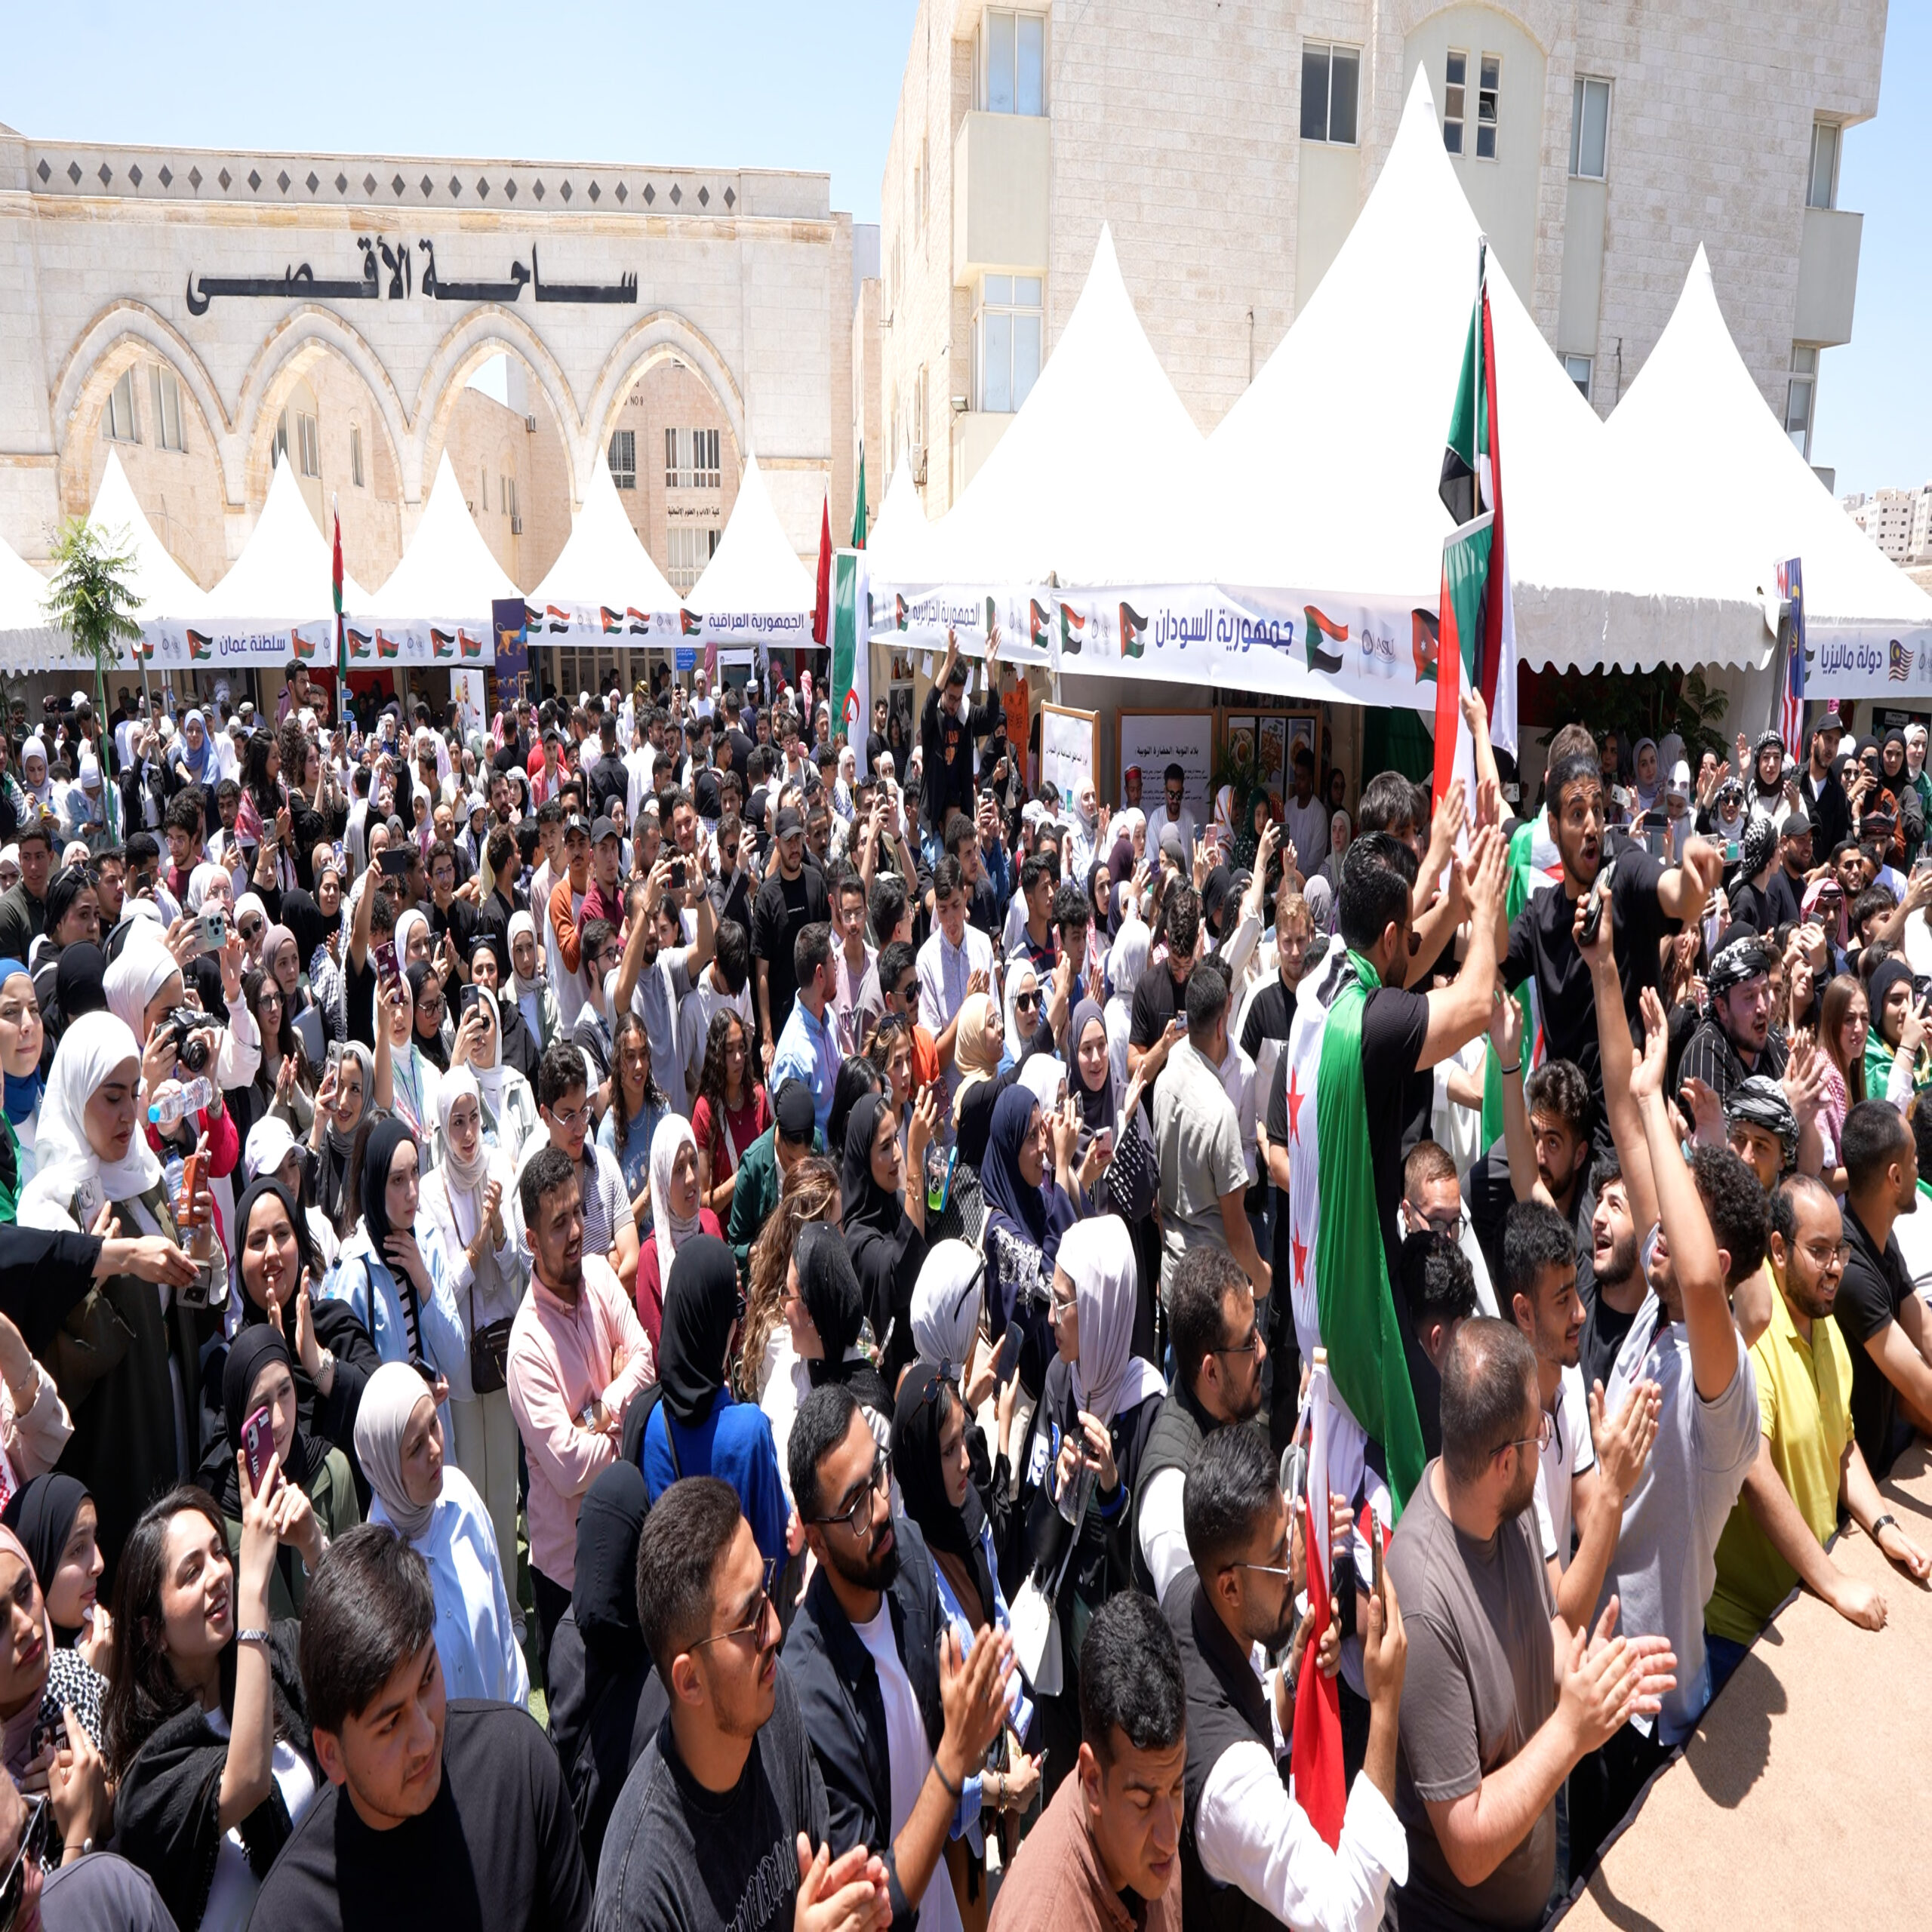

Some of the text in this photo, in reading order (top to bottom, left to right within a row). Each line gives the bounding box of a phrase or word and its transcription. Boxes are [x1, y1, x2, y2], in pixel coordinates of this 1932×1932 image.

[419, 237, 638, 303] ساحة
[709, 612, 804, 632] الجمهورية العراقية
[941, 601, 980, 630] الجمهورية
[251, 635, 285, 652] سلطنة
[1155, 608, 1294, 655] جمهورية السودان
[1376, 637, 1395, 656] ASU
[1821, 645, 1882, 675] دولة ماليزيا
